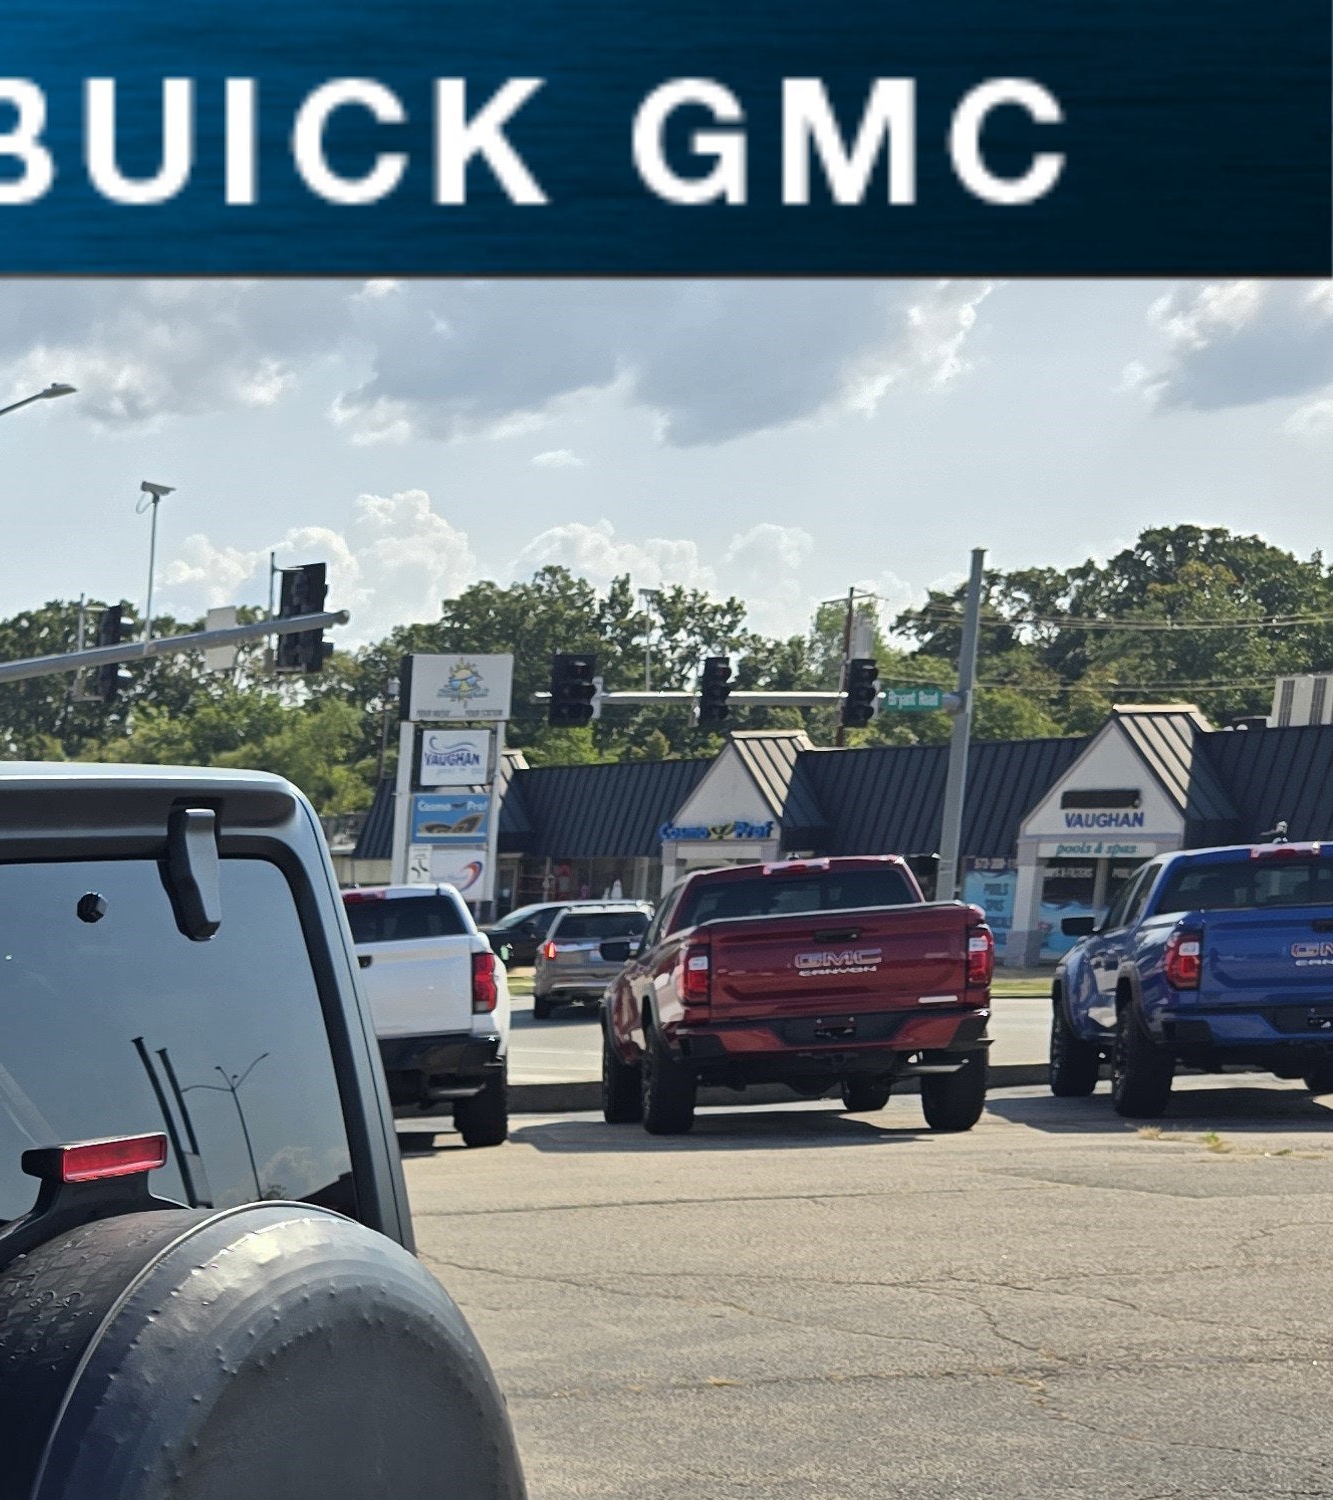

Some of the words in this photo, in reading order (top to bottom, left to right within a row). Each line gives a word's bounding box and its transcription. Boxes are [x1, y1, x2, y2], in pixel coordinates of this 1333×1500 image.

[424, 753, 480, 767] VAUGHAN
[1064, 811, 1145, 828] VAUGHAN
[794, 948, 883, 969] GMC
